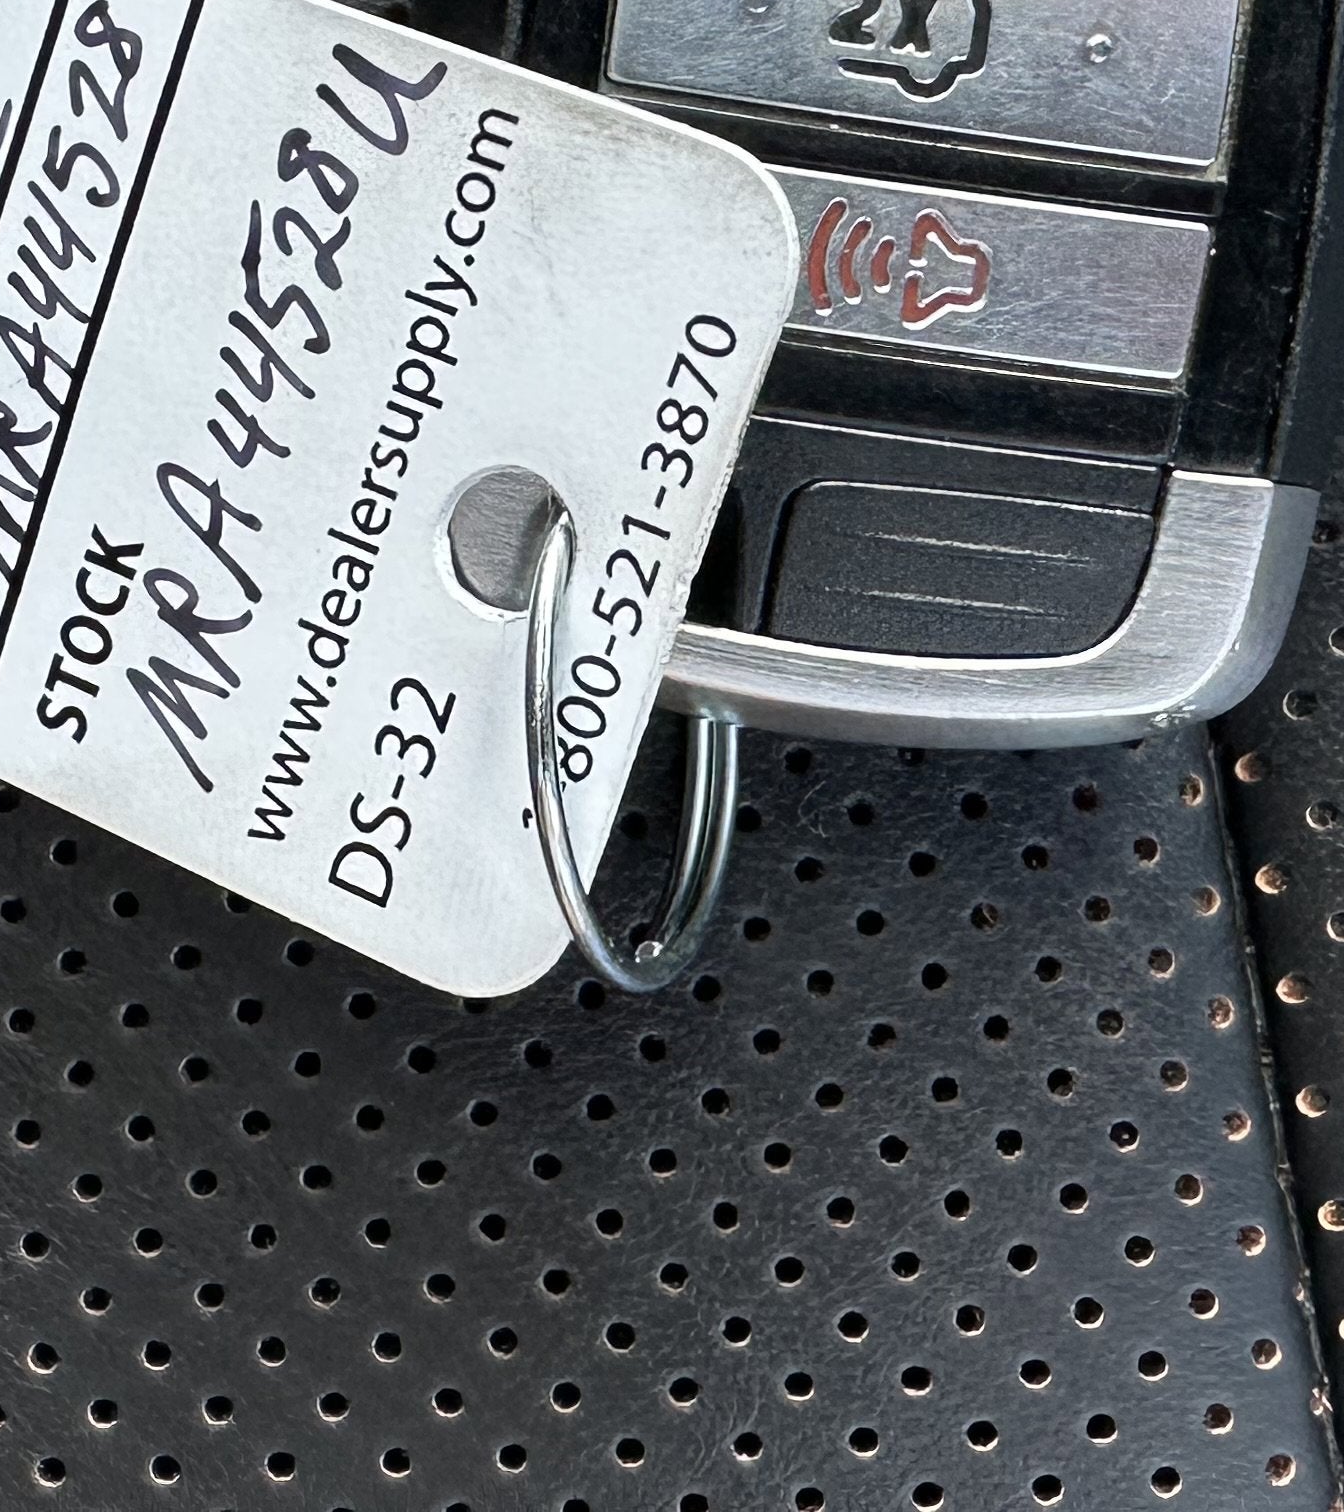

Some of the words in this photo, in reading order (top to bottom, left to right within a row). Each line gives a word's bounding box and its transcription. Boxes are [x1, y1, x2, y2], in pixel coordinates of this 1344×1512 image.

[36, 524, 143, 742] STOCK
[126, 44, 447, 792] MRA44528U
[249, 107, 520, 841] www.dealersupply.com
[522, 313, 737, 829] 800-521-3870
[329, 675, 457, 907] DS-32
